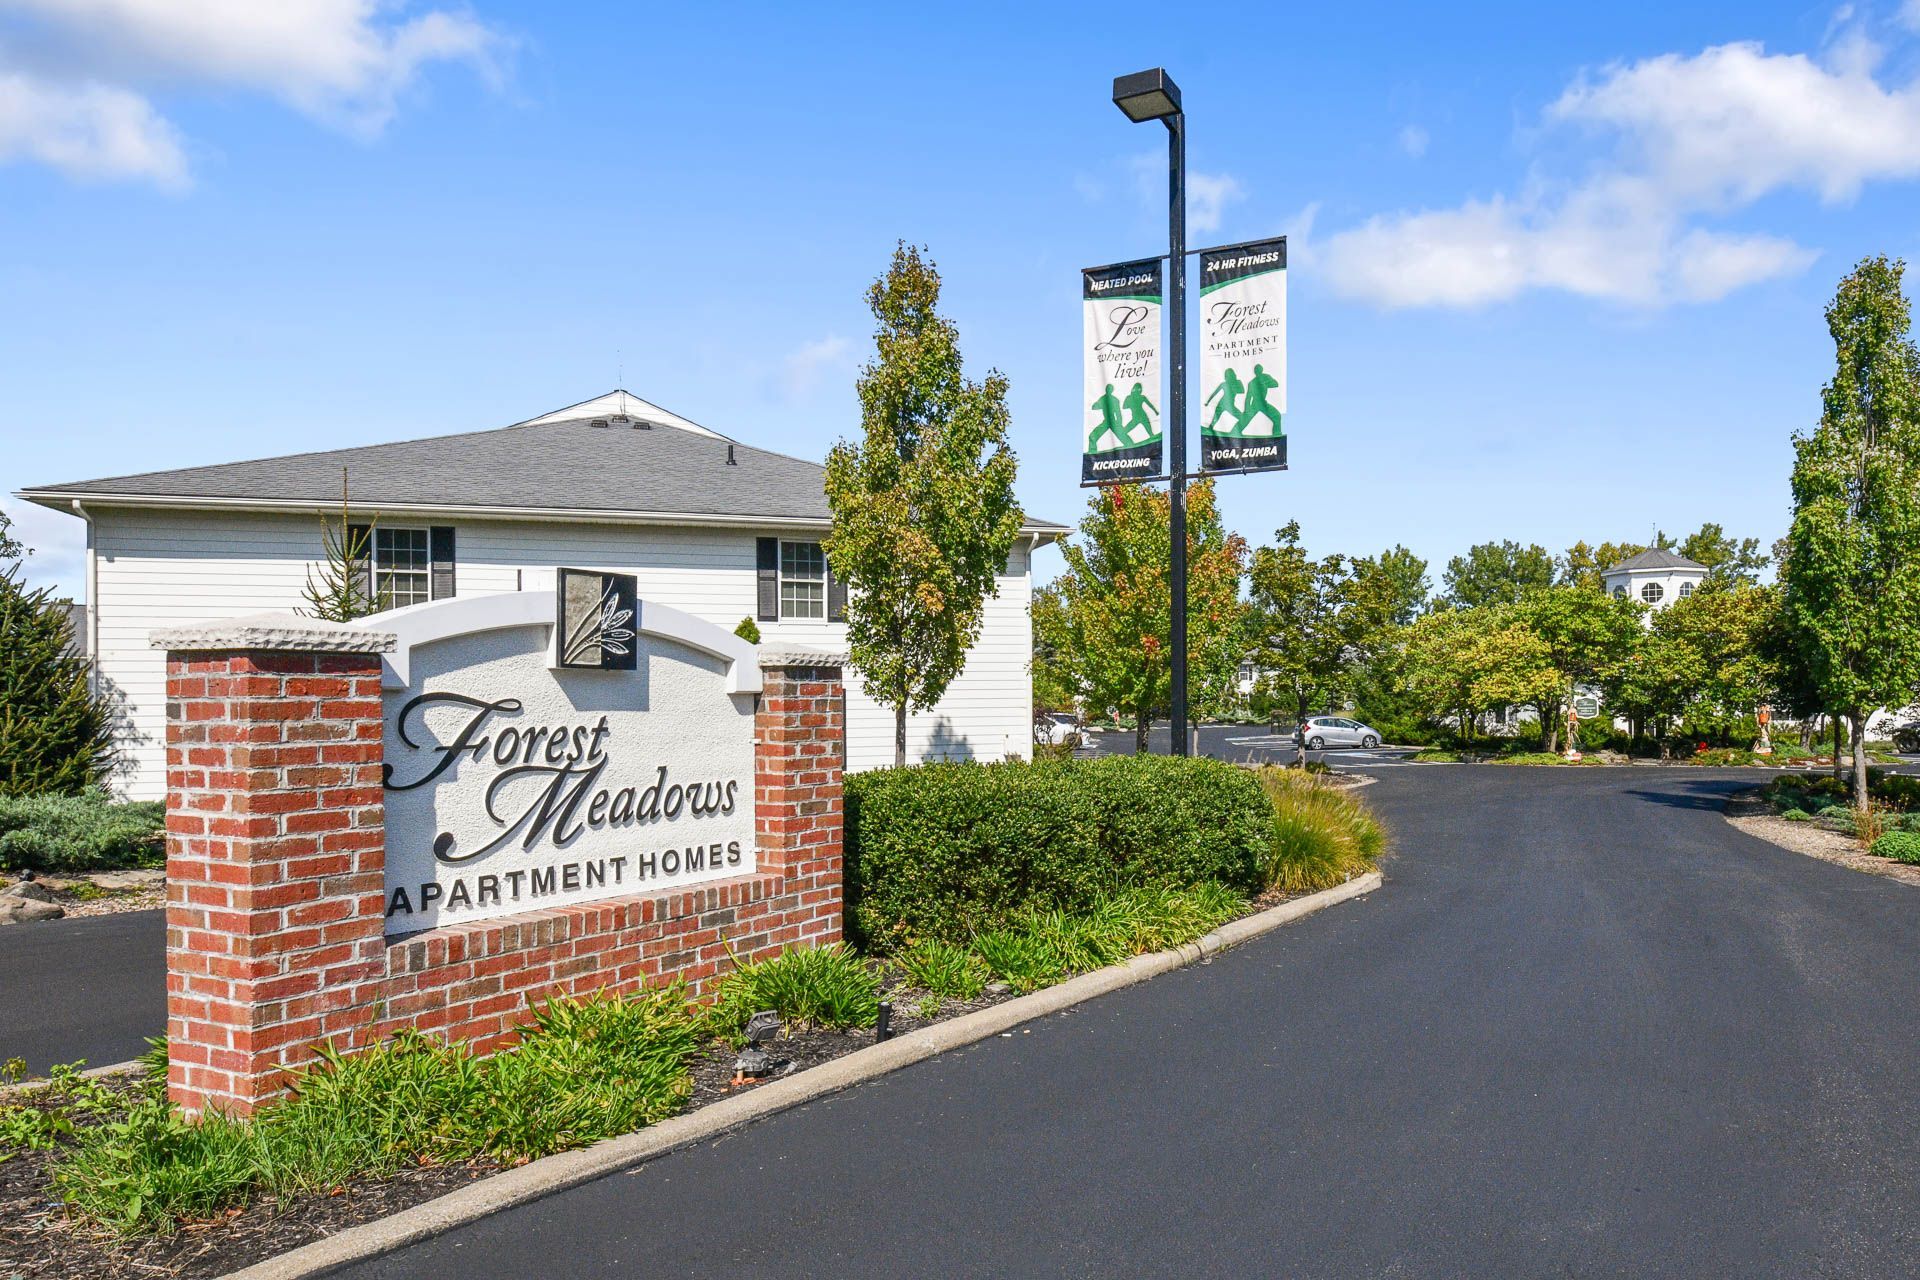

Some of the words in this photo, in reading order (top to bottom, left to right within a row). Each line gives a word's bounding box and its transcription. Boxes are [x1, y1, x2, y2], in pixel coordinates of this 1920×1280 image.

[1207, 261, 1220, 272] 24
[1221, 258, 1236, 270] HR
[1238, 251, 1279, 267] FITNESS
[1091, 277, 1127, 291] HEATED
[1128, 273, 1153, 286] POOL
[1207, 300, 1267, 325] Forest
[1094, 306, 1149, 351] Love
[1211, 316, 1279, 337] Meadows
[1208, 335, 1279, 351] APARTMENT
[1224, 347, 1264, 359] HOMES
[1097, 349, 1132, 364] where
[1133, 348, 1154, 363] you
[1114, 360, 1147, 379] live!
[1210, 448, 1240, 461] YOGA,
[1242, 445, 1278, 458] ZUMBA
[1092, 457, 1151, 471] KICKBOXING
[383, 691, 610, 791] Forest
[432, 752, 738, 863] Meadows
[385, 856, 627, 918] APARTMENT
[638, 840, 742, 877] HOMES
